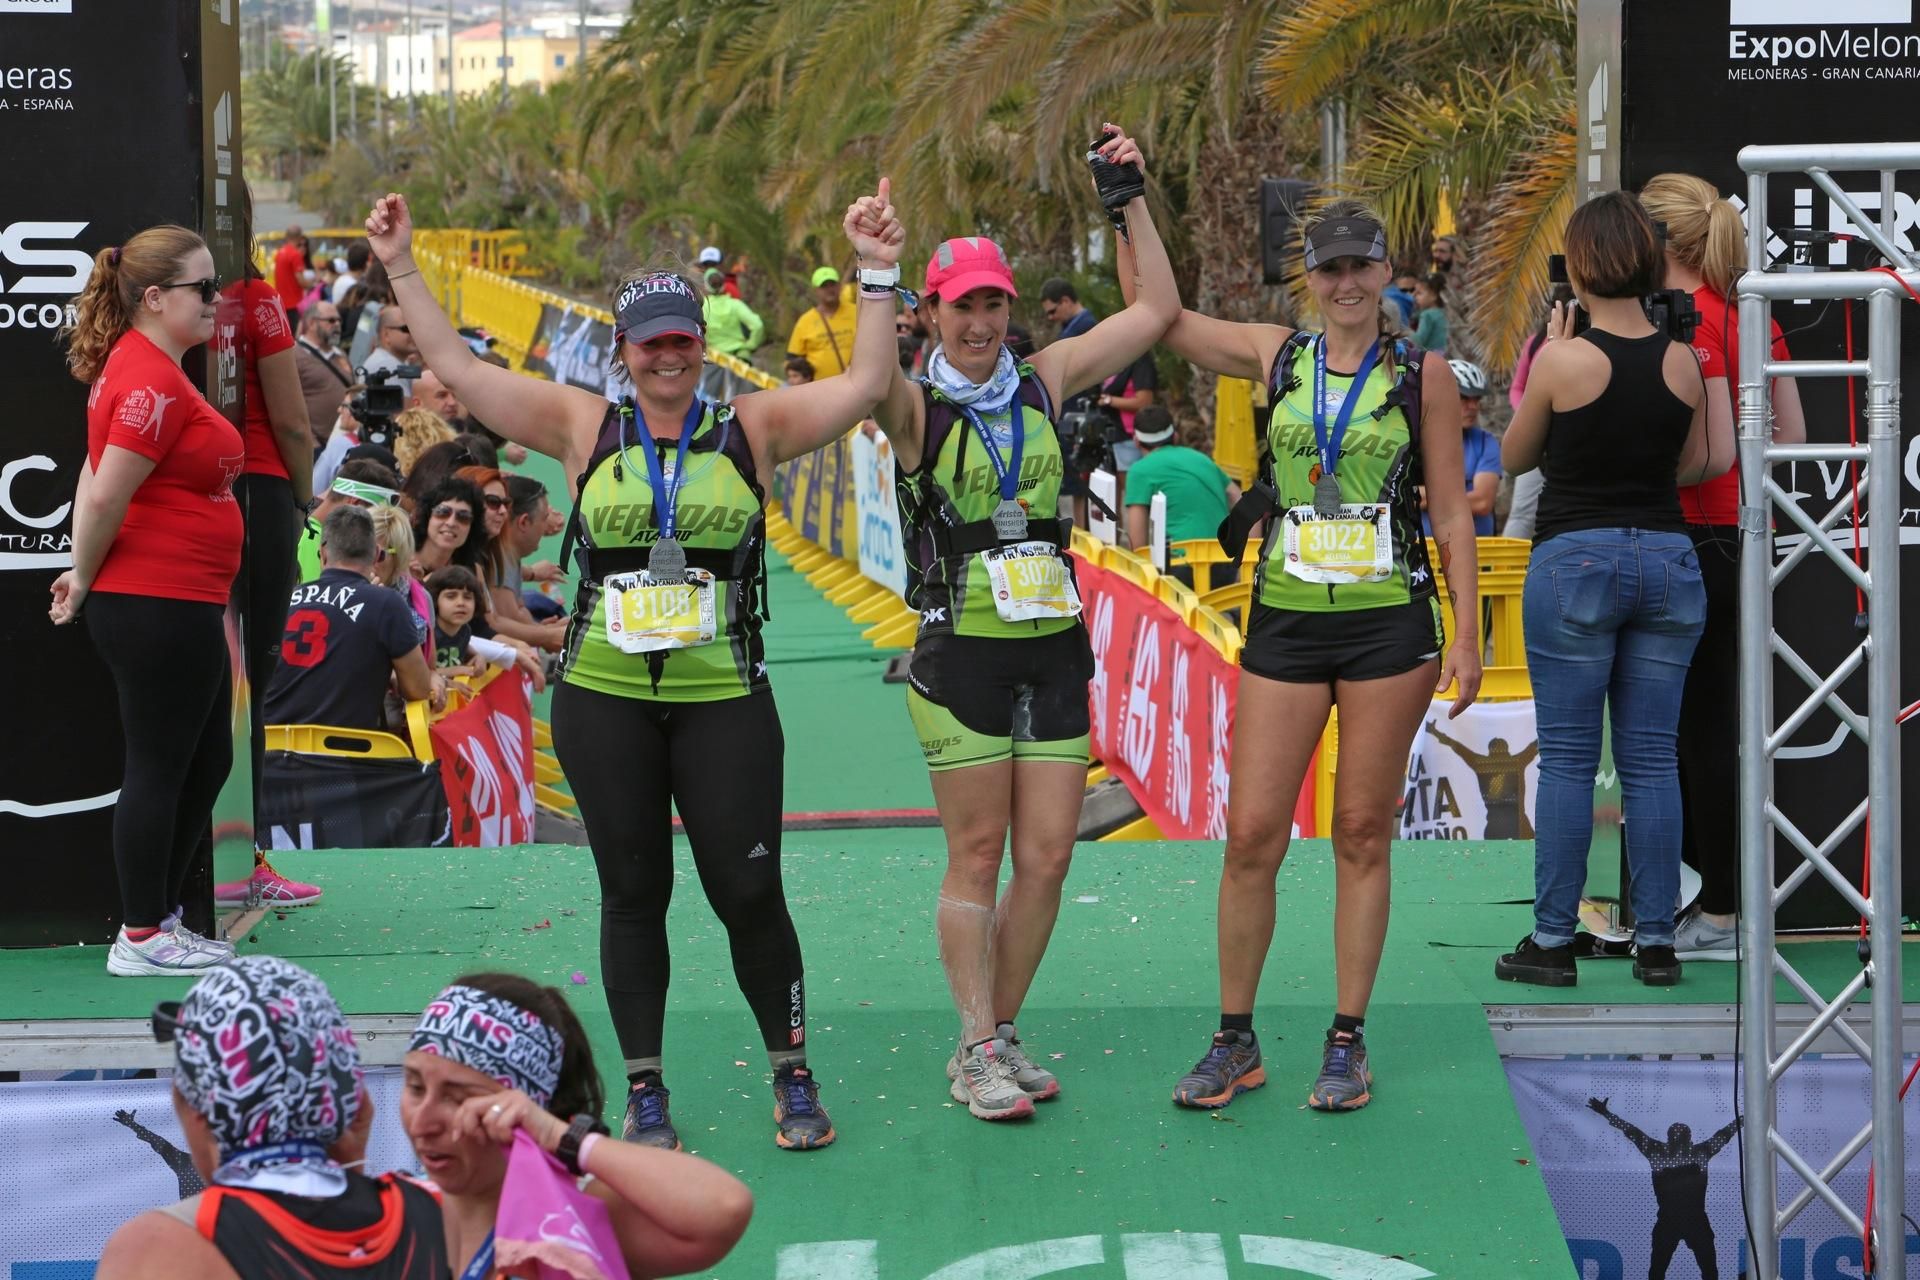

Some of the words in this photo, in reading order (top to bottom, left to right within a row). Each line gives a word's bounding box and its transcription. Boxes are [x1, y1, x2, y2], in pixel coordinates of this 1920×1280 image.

[0, 67, 73, 90] eras
[1728, 68, 1808, 80] MELONERAS
[1822, 67, 1860, 79] GRAN
[23, 97, 74, 111] ESPAÑA
[123, 396, 150, 410] META
[125, 413, 146, 425] GOAL
[593, 503, 749, 536] VERDAS
[1309, 523, 1366, 552] 3022
[658, 578, 685, 588] CANARIA
[289, 584, 365, 622] SPAÑA
[631, 588, 691, 620] 3108
[281, 608, 331, 669] 3
[1116, 687, 1128, 758] PORT
